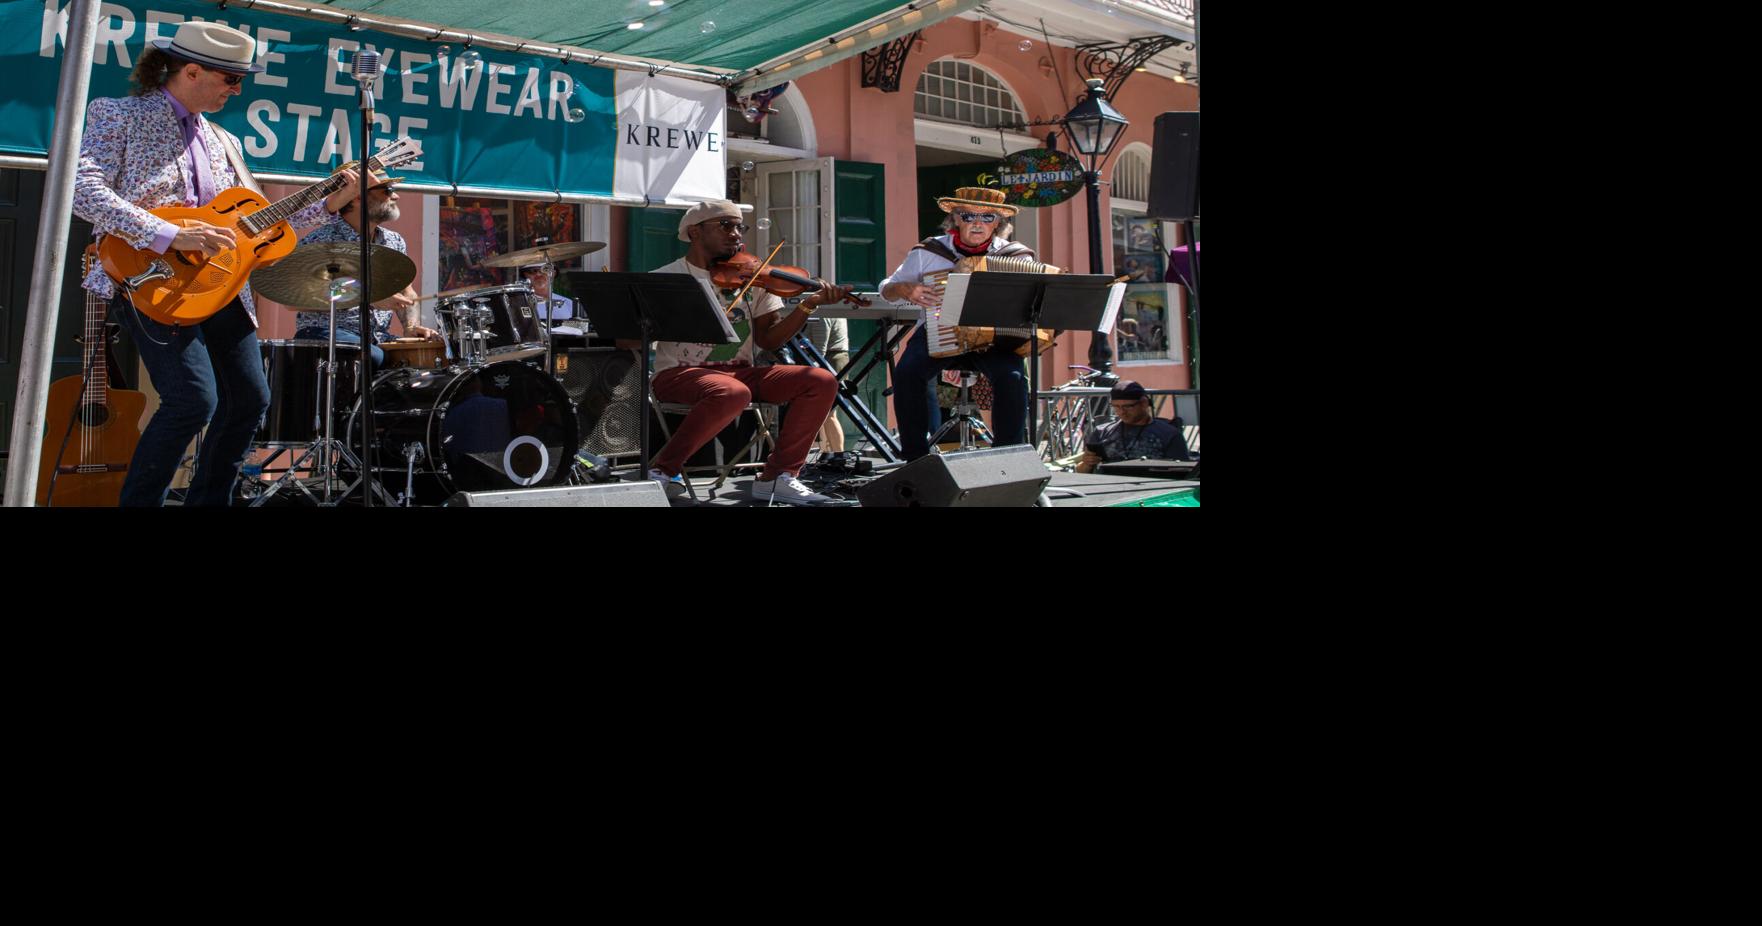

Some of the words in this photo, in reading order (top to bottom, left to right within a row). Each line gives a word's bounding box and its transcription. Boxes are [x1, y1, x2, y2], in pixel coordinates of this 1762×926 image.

[40, 0, 291, 88] KREE
[324, 37, 574, 122] EYEWEAR
[626, 123, 719, 153] KREWE
[1002, 174, 1017, 185] LE
[1025, 171, 1073, 183] JARDIN
